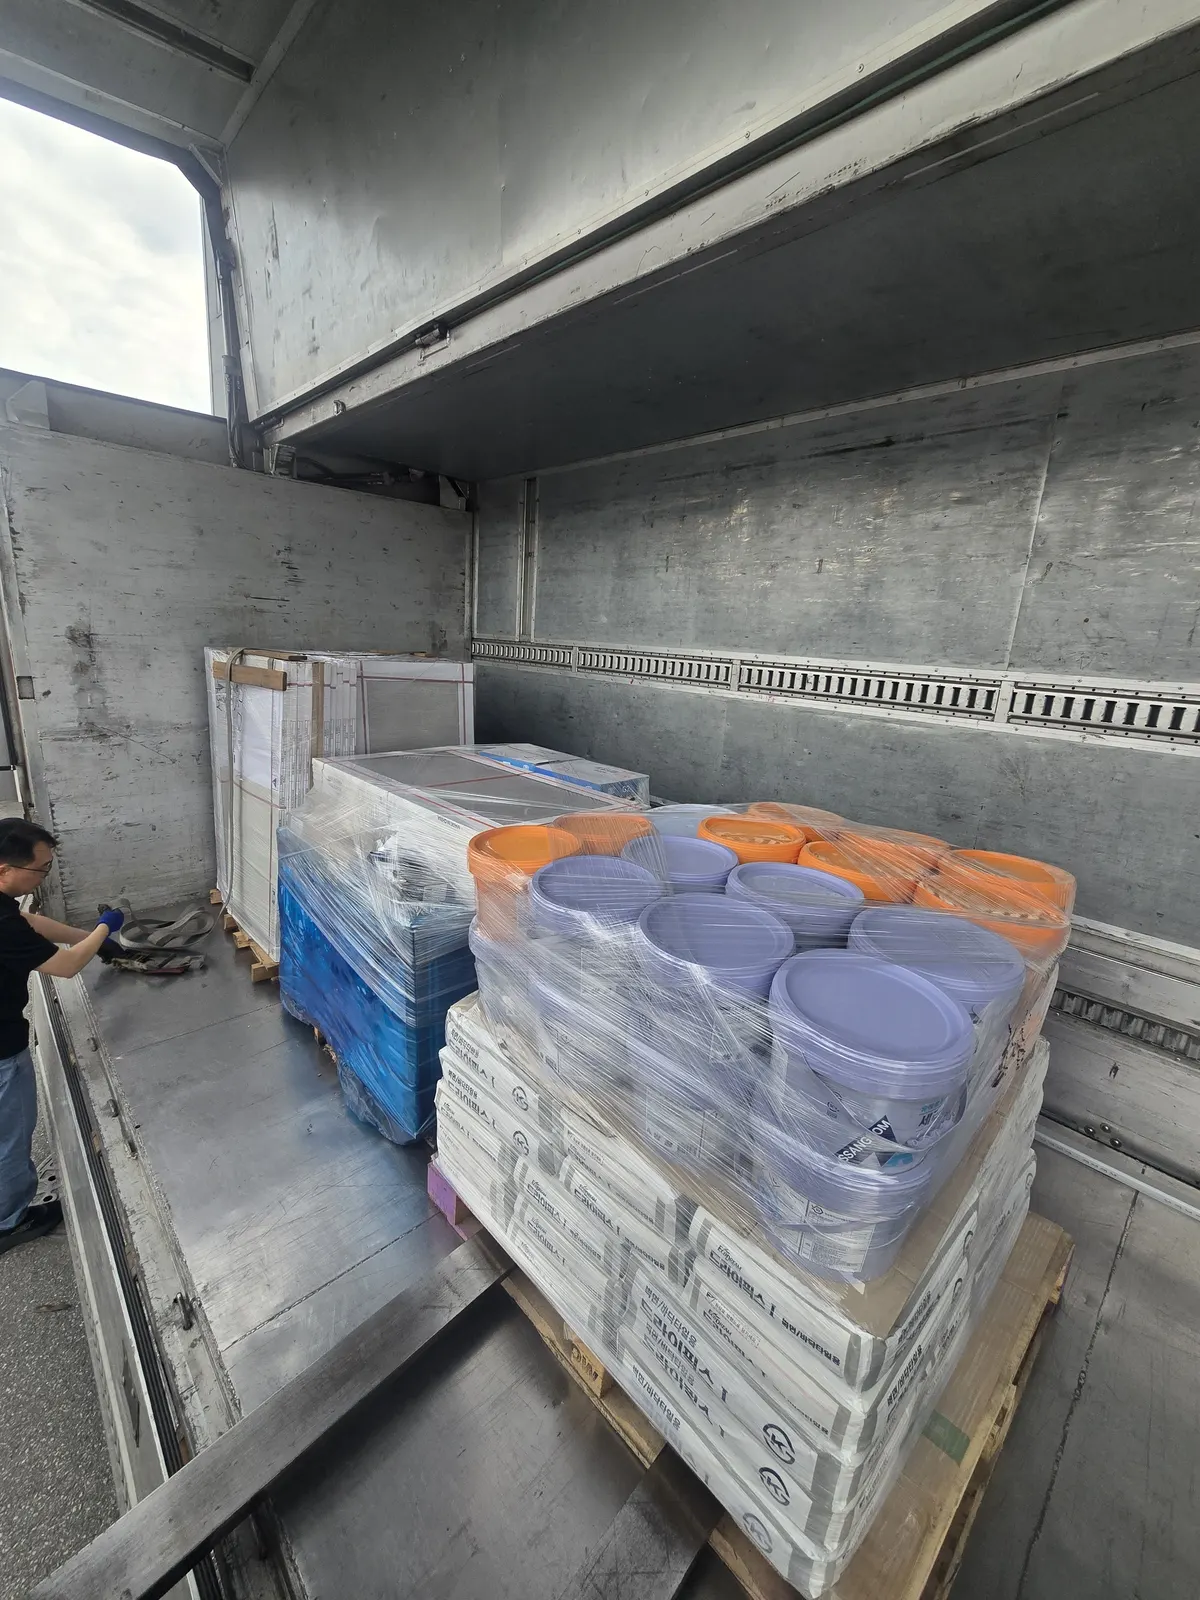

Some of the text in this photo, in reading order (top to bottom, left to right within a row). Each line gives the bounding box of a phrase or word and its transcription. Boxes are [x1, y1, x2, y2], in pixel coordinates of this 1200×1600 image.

[837, 1119, 891, 1163] SSANGOM
[639, 1297, 714, 1390] 드라이픽스
[644, 1285, 697, 1349] 벽면/바닥타일용
[632, 1363, 682, 1431] 벽면/바닥타일용
